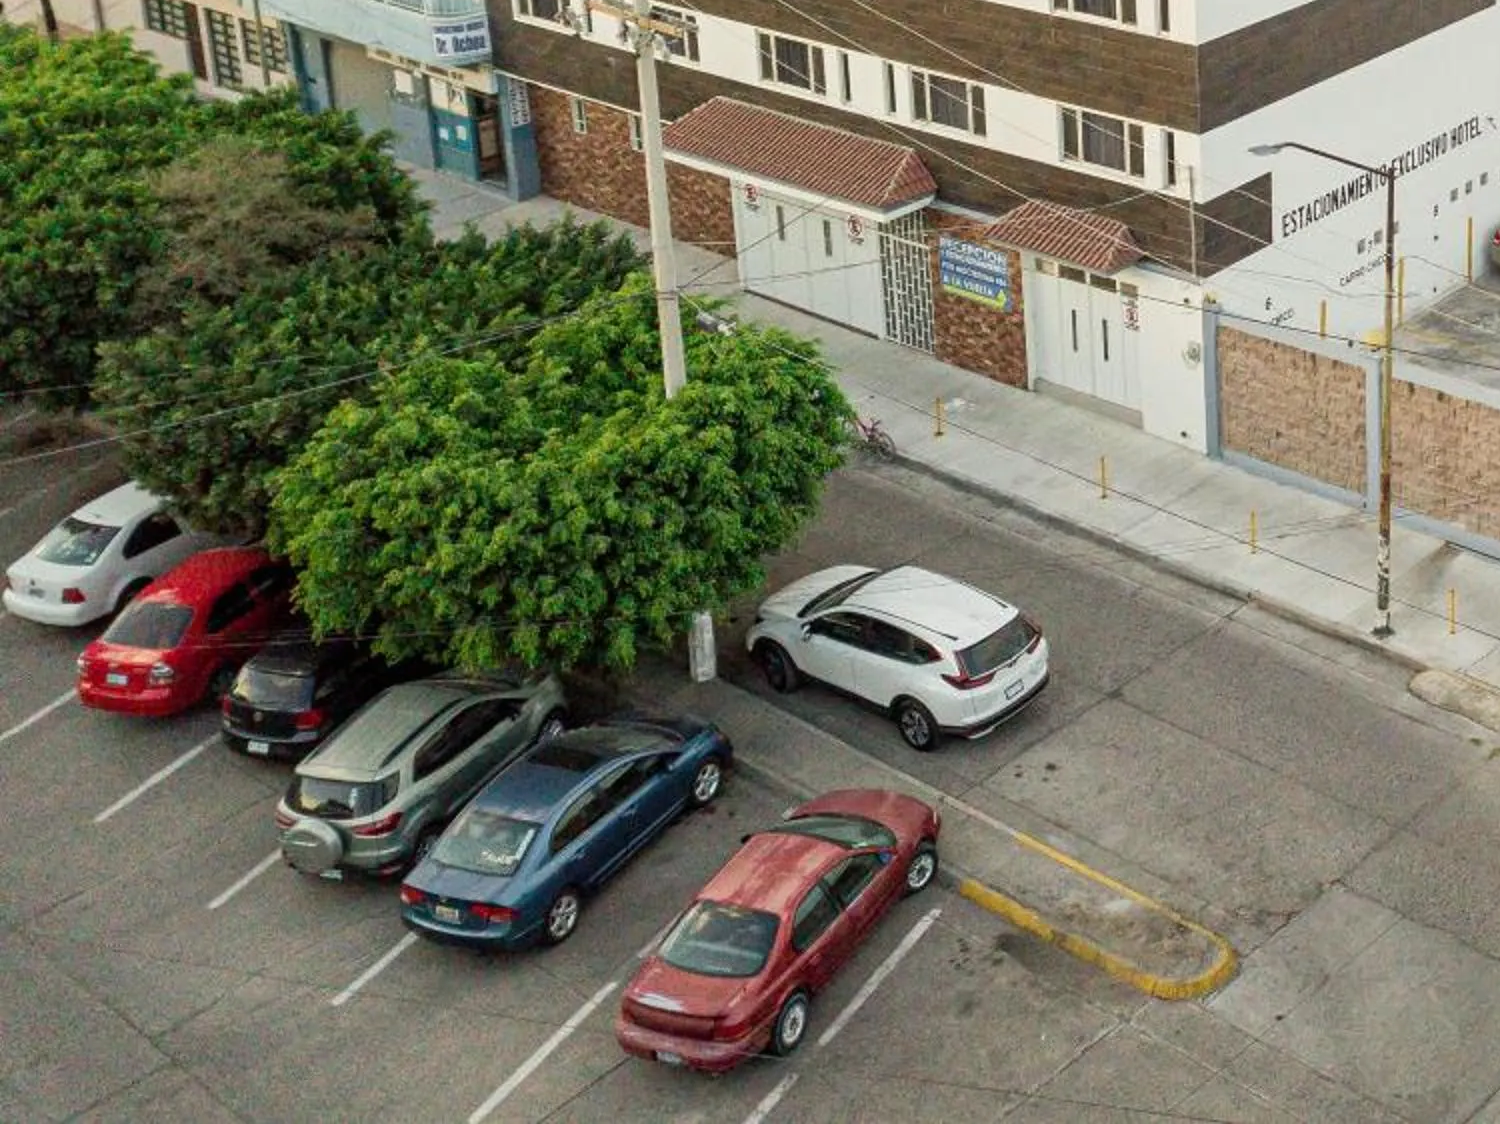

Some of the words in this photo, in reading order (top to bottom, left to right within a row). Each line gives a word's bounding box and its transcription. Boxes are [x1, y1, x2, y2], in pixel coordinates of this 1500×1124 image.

[1282, 163, 1388, 238] ESTACIONAMIENTO
[1391, 132, 1448, 178] EXCLUSIVO
[1450, 115, 1482, 149] HOTEL
